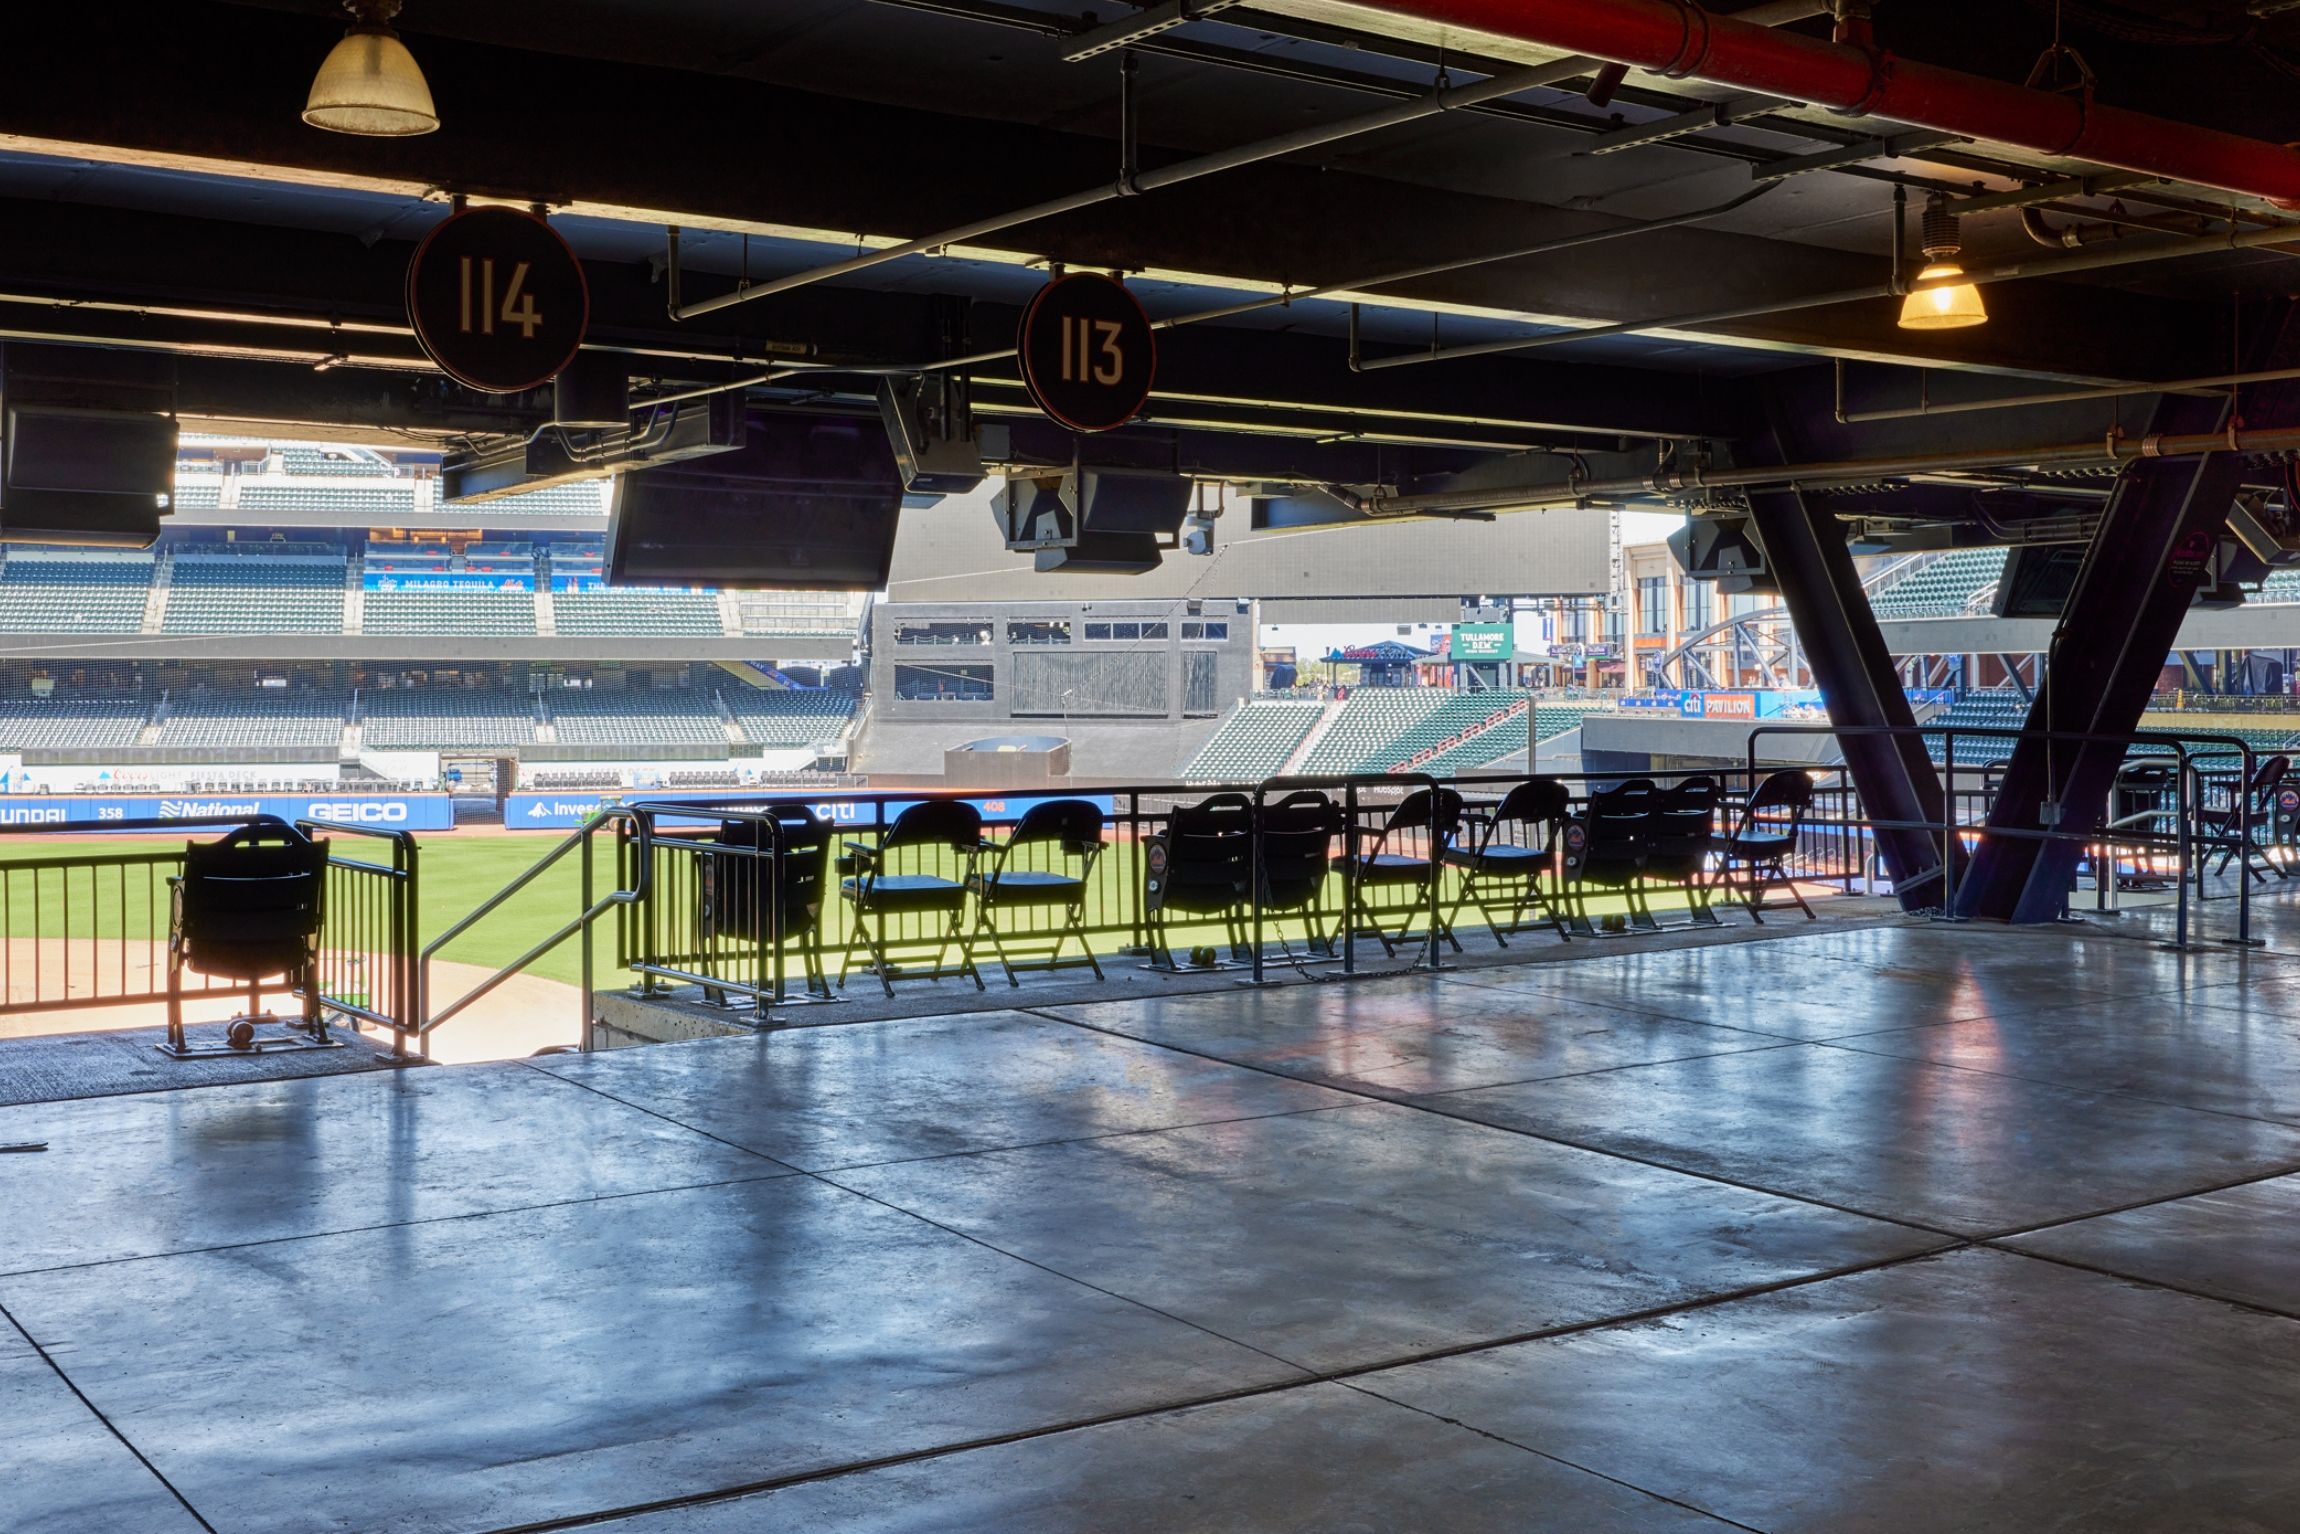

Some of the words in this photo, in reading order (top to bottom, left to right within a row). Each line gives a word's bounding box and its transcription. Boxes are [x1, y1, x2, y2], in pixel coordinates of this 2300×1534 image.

[460, 257, 543, 338] 114
[1062, 316, 1123, 386] 113
[405, 580, 449, 589] MILAGRO
[453, 580, 495, 589] TEQUILA
[1460, 633, 1504, 641] TULLAMORE
[1706, 700, 1750, 713] PAVILION
[98, 807, 124, 819] 358
[182, 802, 260, 817] National
[308, 803, 408, 821] GEICO
[984, 802, 1006, 812] 408
